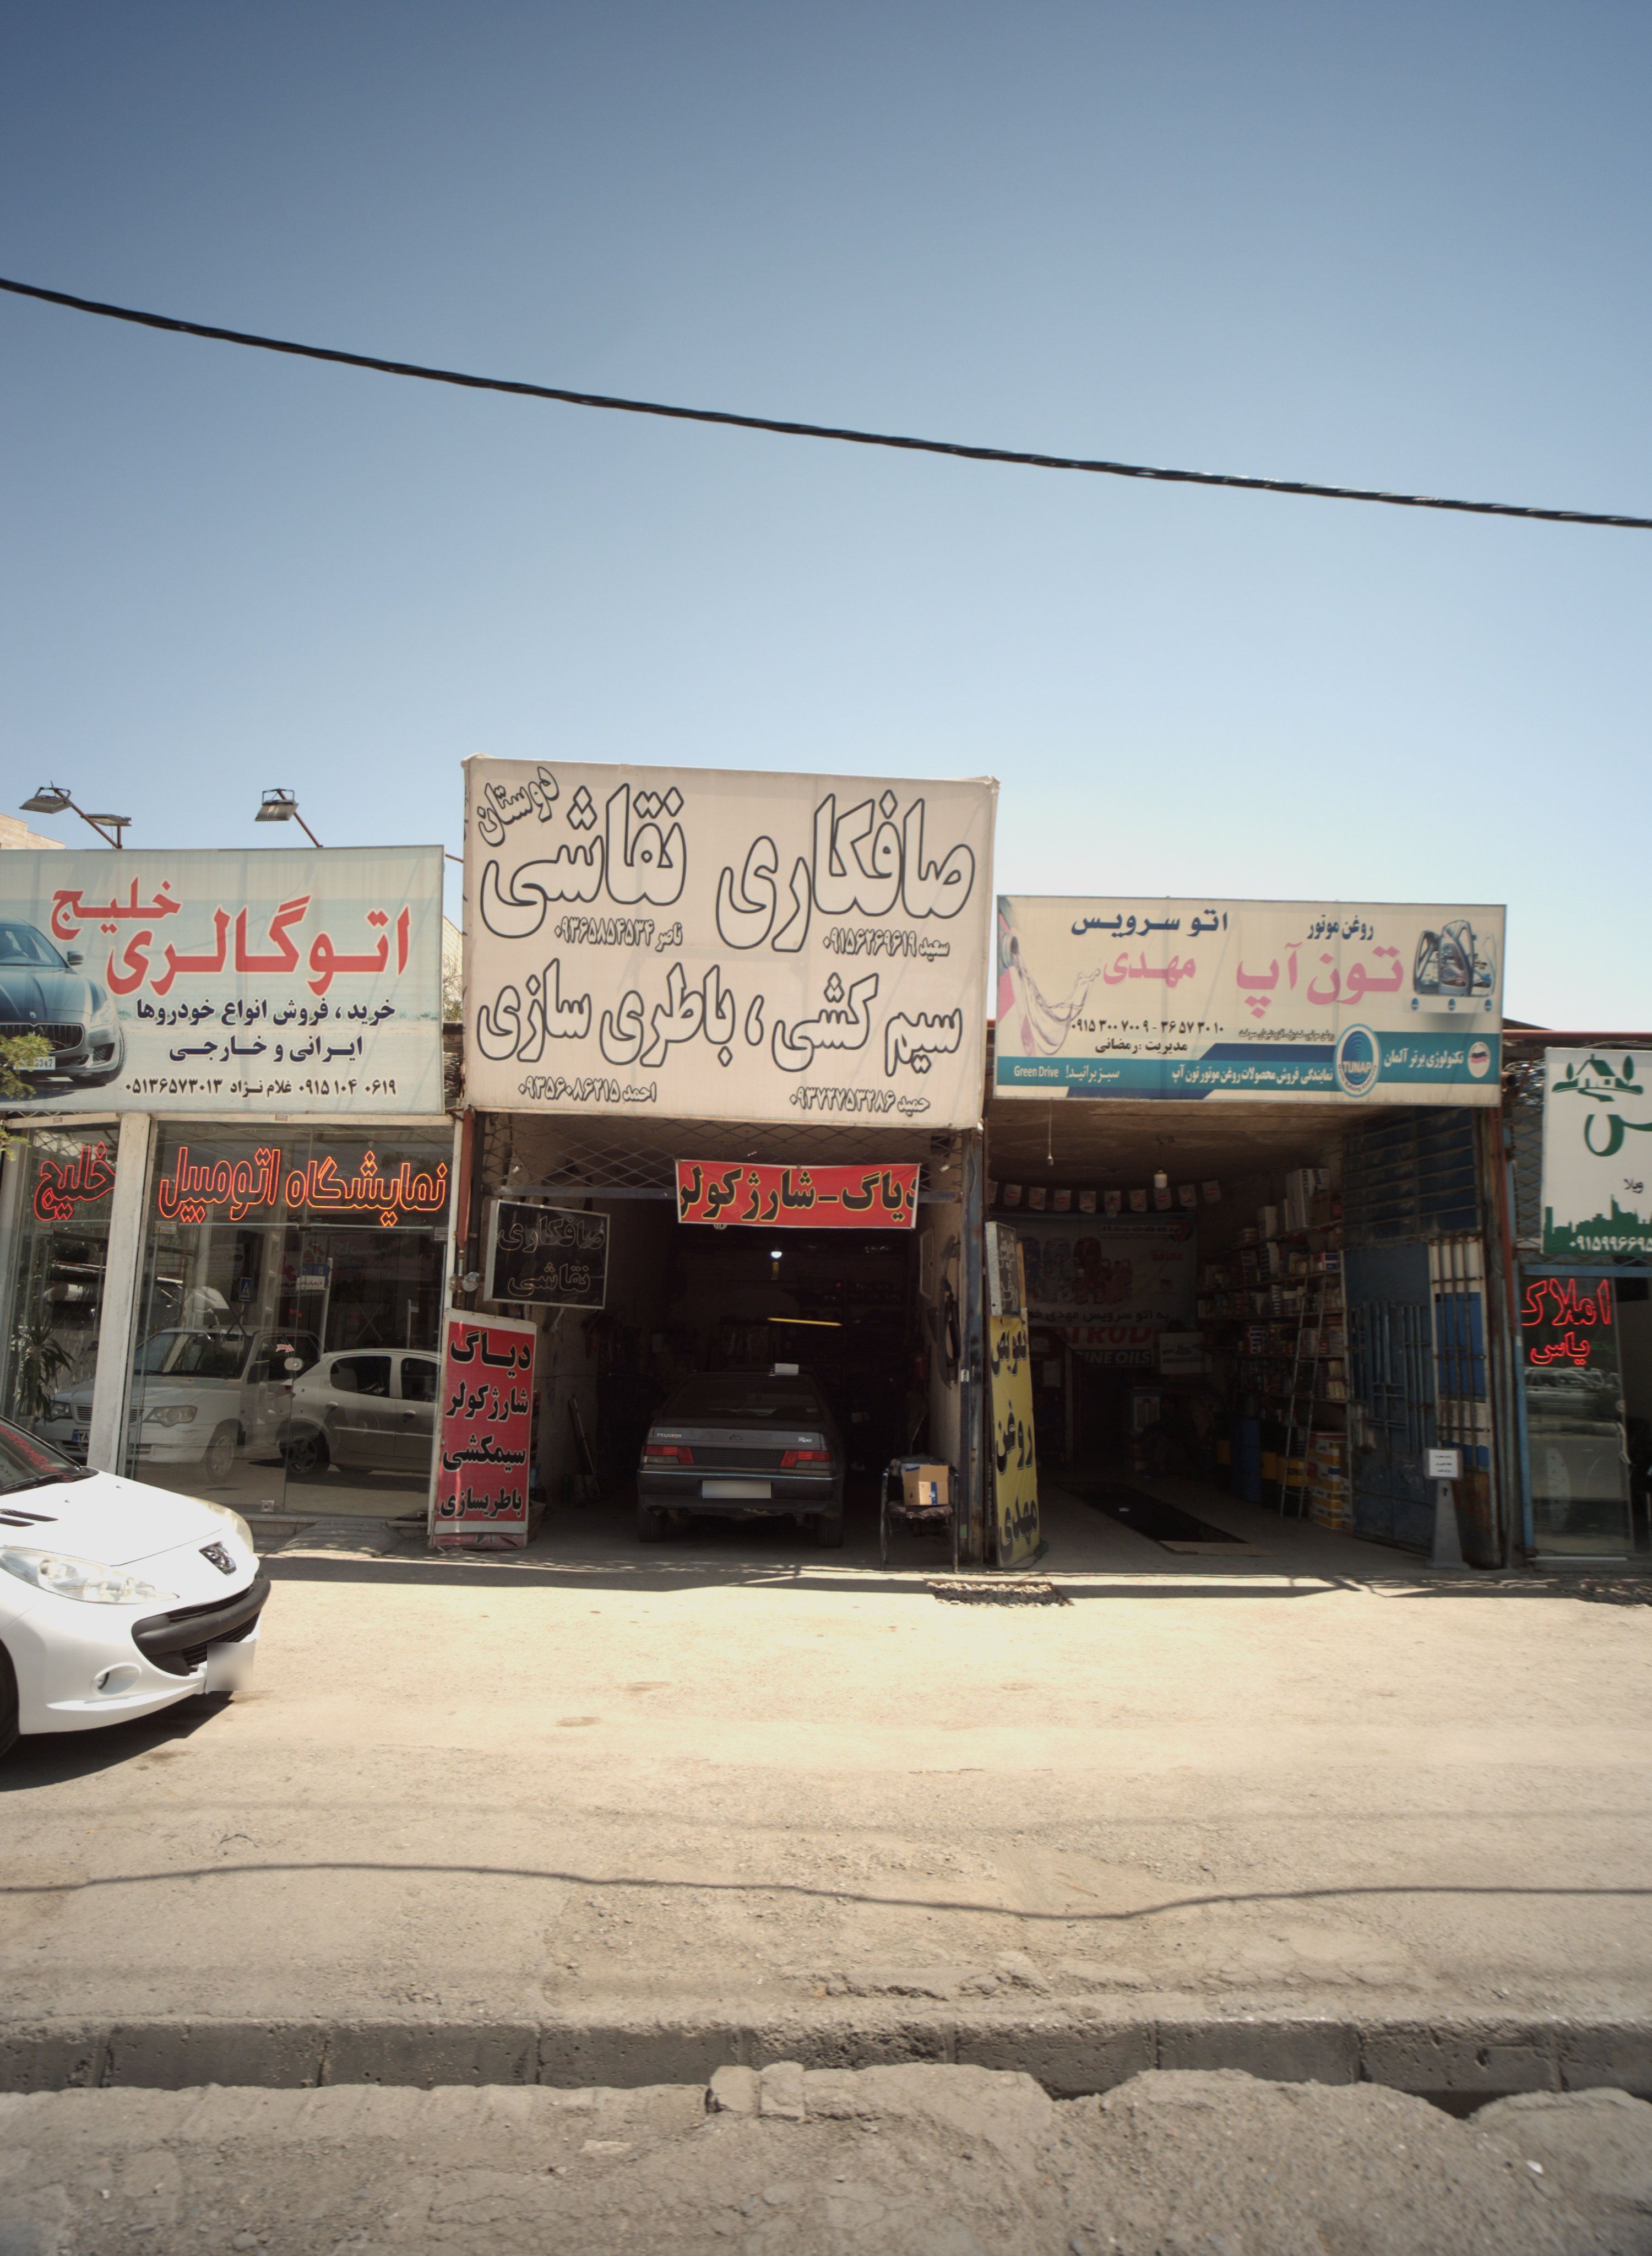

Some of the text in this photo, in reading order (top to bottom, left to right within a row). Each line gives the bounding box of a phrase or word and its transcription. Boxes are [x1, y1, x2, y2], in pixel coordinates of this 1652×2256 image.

[481, 783, 686, 939] نقاشی
[716, 789, 975, 953] صافکاری
[50, 875, 182, 940] خلیج
[655, 921, 683, 953] ناصر
[1071, 909, 1228, 938] اتو سرویس
[1307, 914, 1374, 940] روغن موتور
[1103, 951, 1197, 989] مهدی
[1236, 941, 1404, 1019] تون آپ
[137, 998, 215, 1026] خودروها
[221, 999, 268, 1026] انواع
[273, 997, 329, 1026] فروش
[347, 998, 396, 1026] خرید
[477, 958, 591, 1062] سازی
[599, 962, 736, 1067] باطری
[169, 1035, 363, 1062] ایرانی و خارجی
[885, 1008, 963, 1077] سیم
[1145, 1040, 1188, 1054] مدیریت
[1014, 1065, 1059, 1077] Green Drive
[1343, 1061, 1372, 1074] TUNAP
[1384, 1048, 1464, 1069] تکنولوژی برتر آلمان
[126, 1078, 223, 1094] ۰۵۱۳۶۵۷۳۰۱۳
[1172, 1064, 1186, 1083] آپ
[1185, 1066, 1200, 1083] تون
[1199, 1066, 1220, 1083] موتور
[1220, 1067, 1241, 1083] روغن
[1241, 1066, 1276, 1084] محصولات
[1276, 1066, 1300, 1084] فروش
[1301, 1067, 1333, 1084] نمایندگی
[622, 1081, 657, 1103] احمد
[34, 1141, 117, 1221] خلیج
[285, 1151, 448, 1227] نمایشگاه
[498, 1216, 605, 1253] صافکاری
[508, 1262, 590, 1297] نقاشی
[1046, 1310, 1079, 1322] مهدی
[1083, 1310, 1132, 1322] سرویس
[1520, 1278, 1612, 1326] املاک
[449, 1330, 532, 1378] دیاگ
[1115, 1351, 1151, 1365] OILS
[1530, 1331, 1590, 1365] یاس
[442, 1433, 527, 1472] سیمکشی
